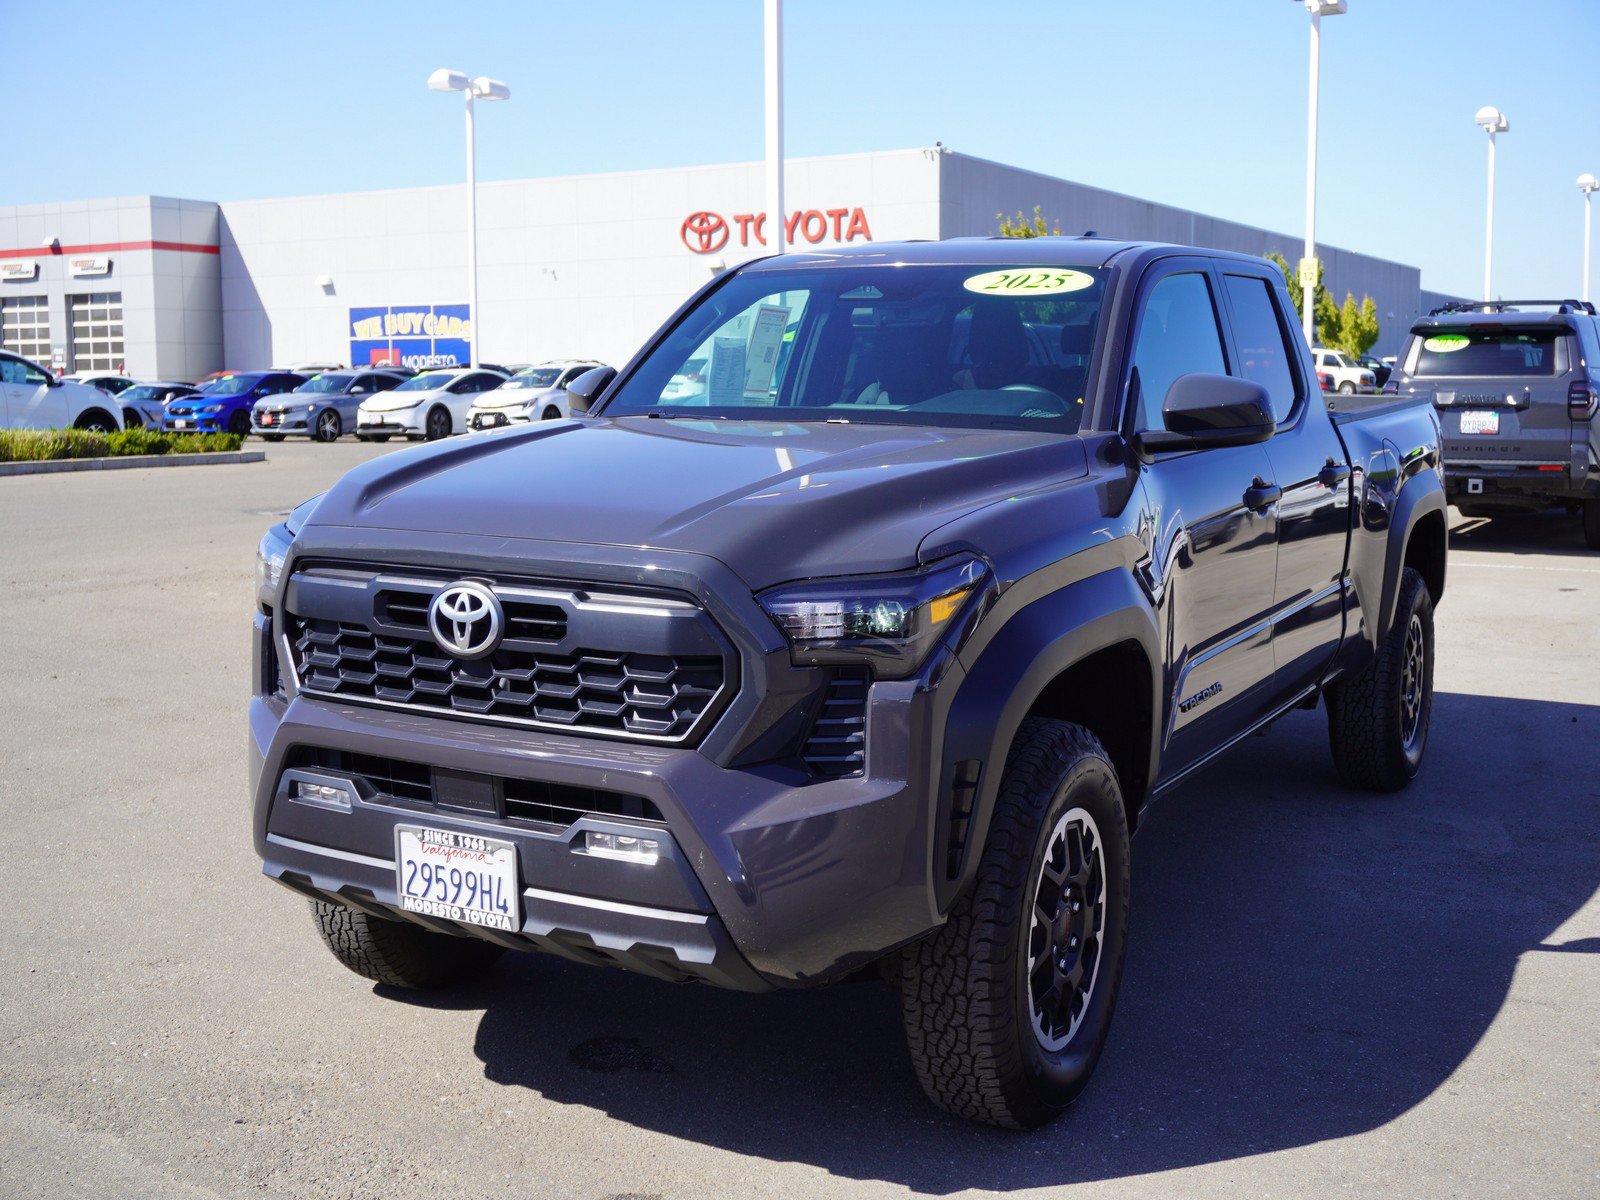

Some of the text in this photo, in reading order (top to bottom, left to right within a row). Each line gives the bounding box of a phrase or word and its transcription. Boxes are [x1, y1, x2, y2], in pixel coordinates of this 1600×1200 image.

[983, 273, 1074, 290] 2025
[352, 312, 471, 342] WE BUY CARS
[1179, 681, 1223, 713] TACOMA
[421, 840, 494, 864] California
[423, 830, 455, 846] SINCE
[406, 859, 509, 914] 29599H4
[403, 897, 512, 930] MODESTO TOYOTA
